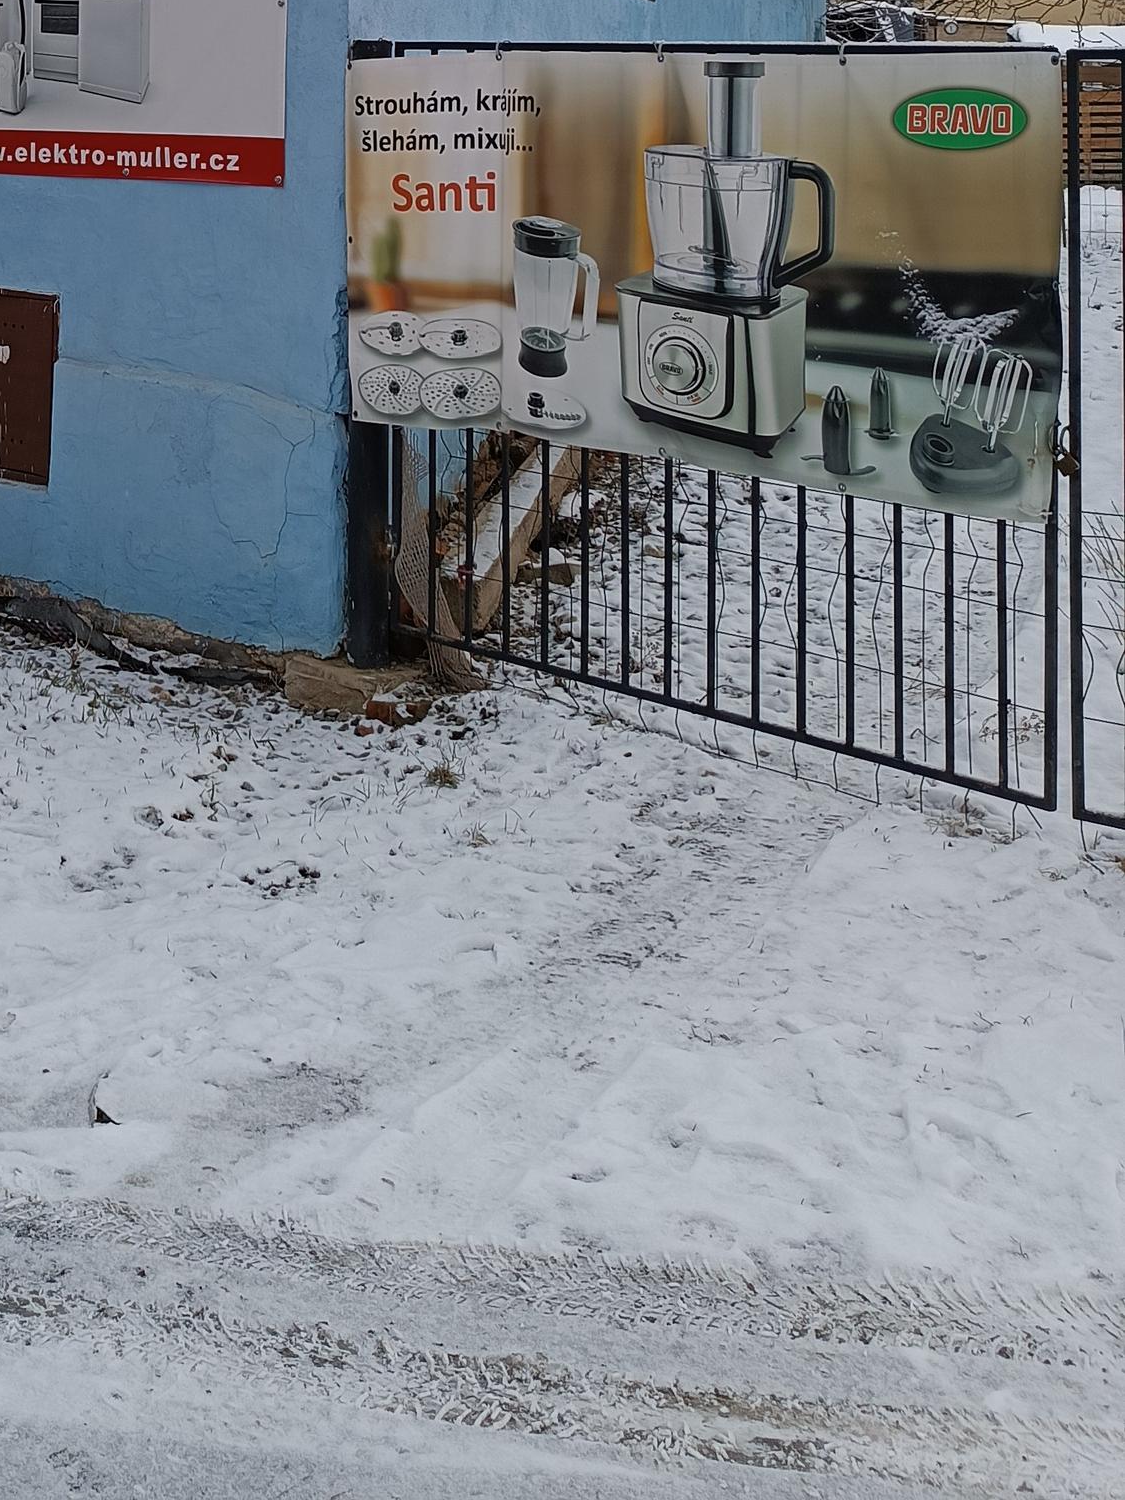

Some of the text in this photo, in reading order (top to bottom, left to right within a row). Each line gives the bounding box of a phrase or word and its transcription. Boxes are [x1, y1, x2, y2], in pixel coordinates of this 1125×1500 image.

[355, 88, 541, 117] Strouhám, krájím,
[907, 104, 1013, 135] BRAVO
[362, 127, 533, 155] šlehám, mixuji...
[392, 172, 496, 212] Santi
